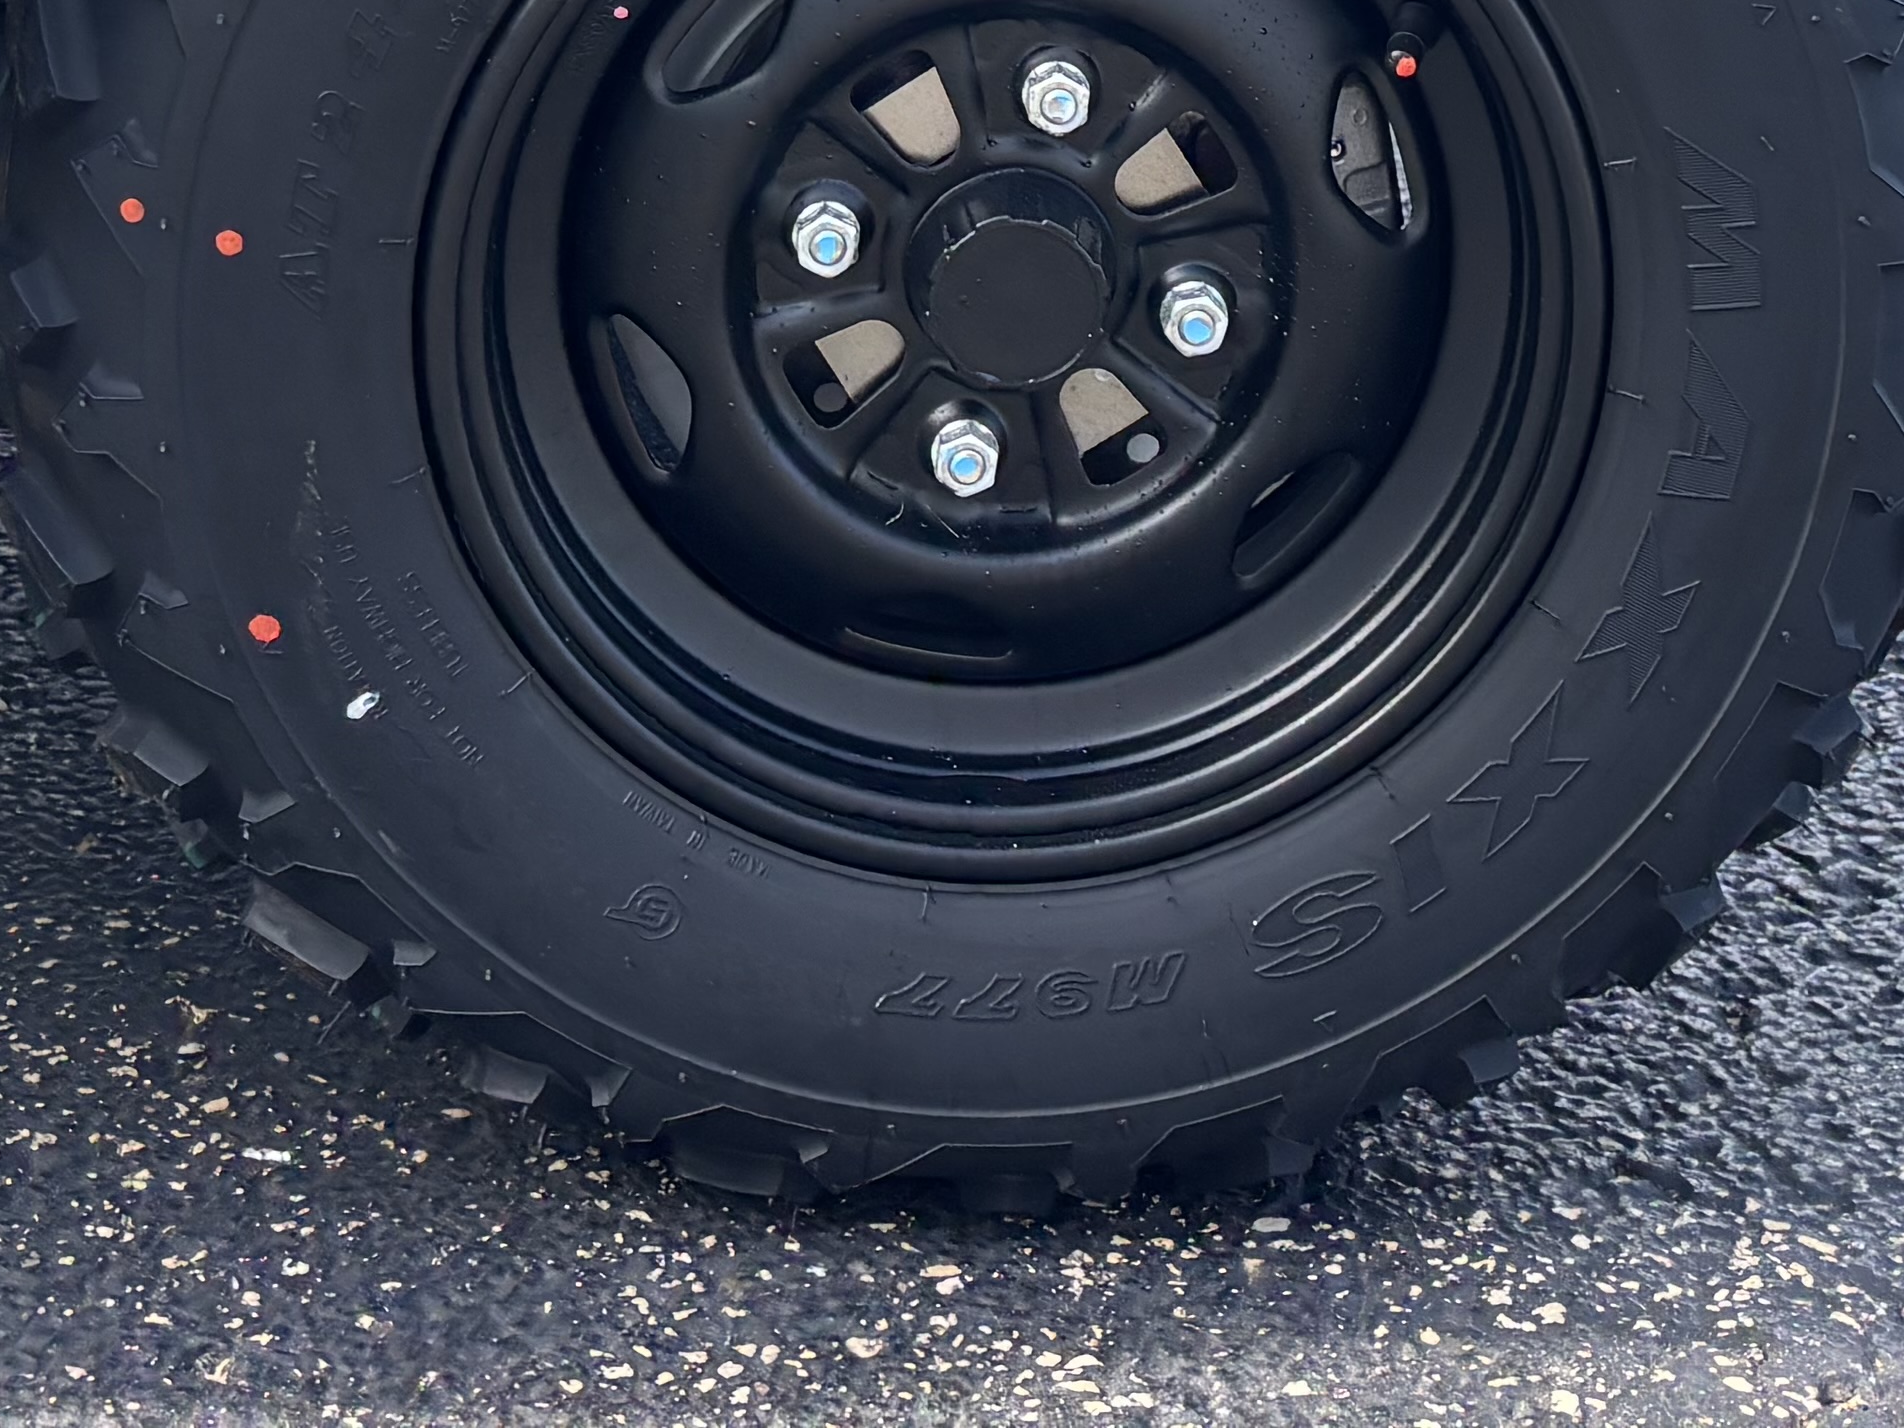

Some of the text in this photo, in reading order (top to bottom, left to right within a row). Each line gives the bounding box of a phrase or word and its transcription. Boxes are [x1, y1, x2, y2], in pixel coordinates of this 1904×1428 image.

[1249, 125, 1766, 979] MAXXIS
[621, 790, 678, 836] TAIWAN
[873, 948, 1187, 1021] M977
